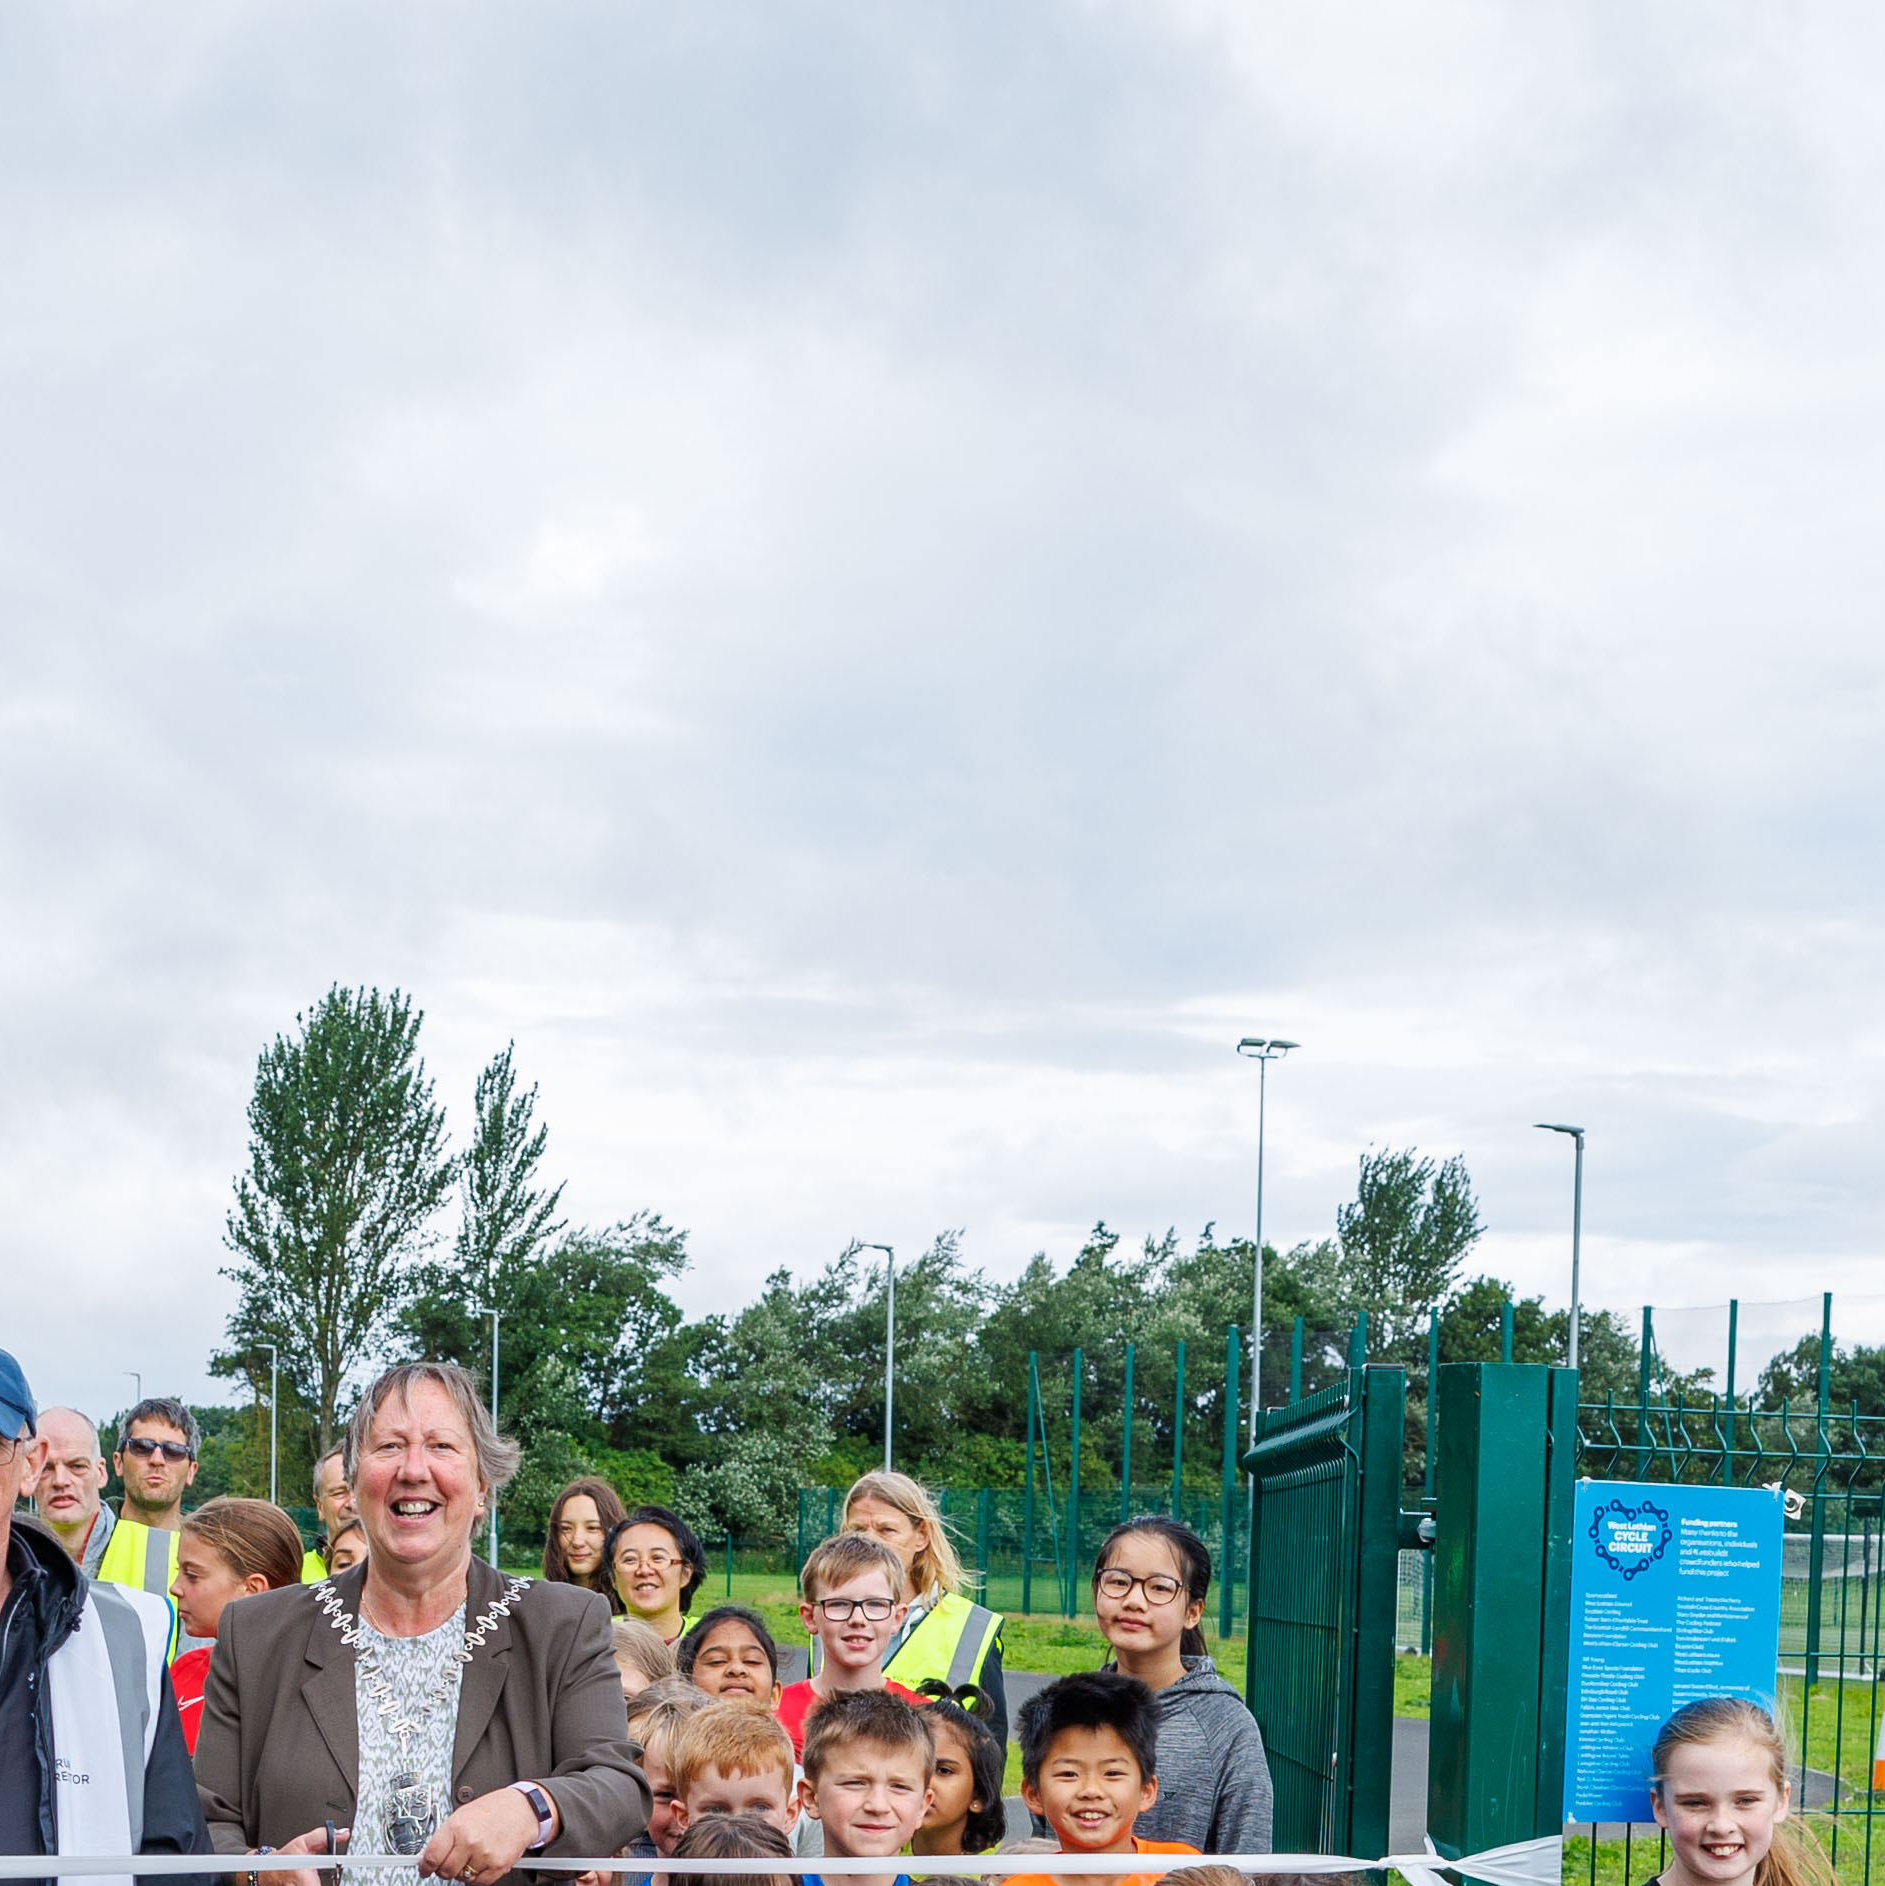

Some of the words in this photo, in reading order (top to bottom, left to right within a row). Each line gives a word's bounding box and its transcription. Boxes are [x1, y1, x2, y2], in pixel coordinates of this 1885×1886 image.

[1607, 1520, 1627, 1530] West
[1628, 1521, 1656, 1531] Lothian
[1614, 1531, 1648, 1542] CYCLE
[1608, 1542, 1653, 1554] CIRCUIT
